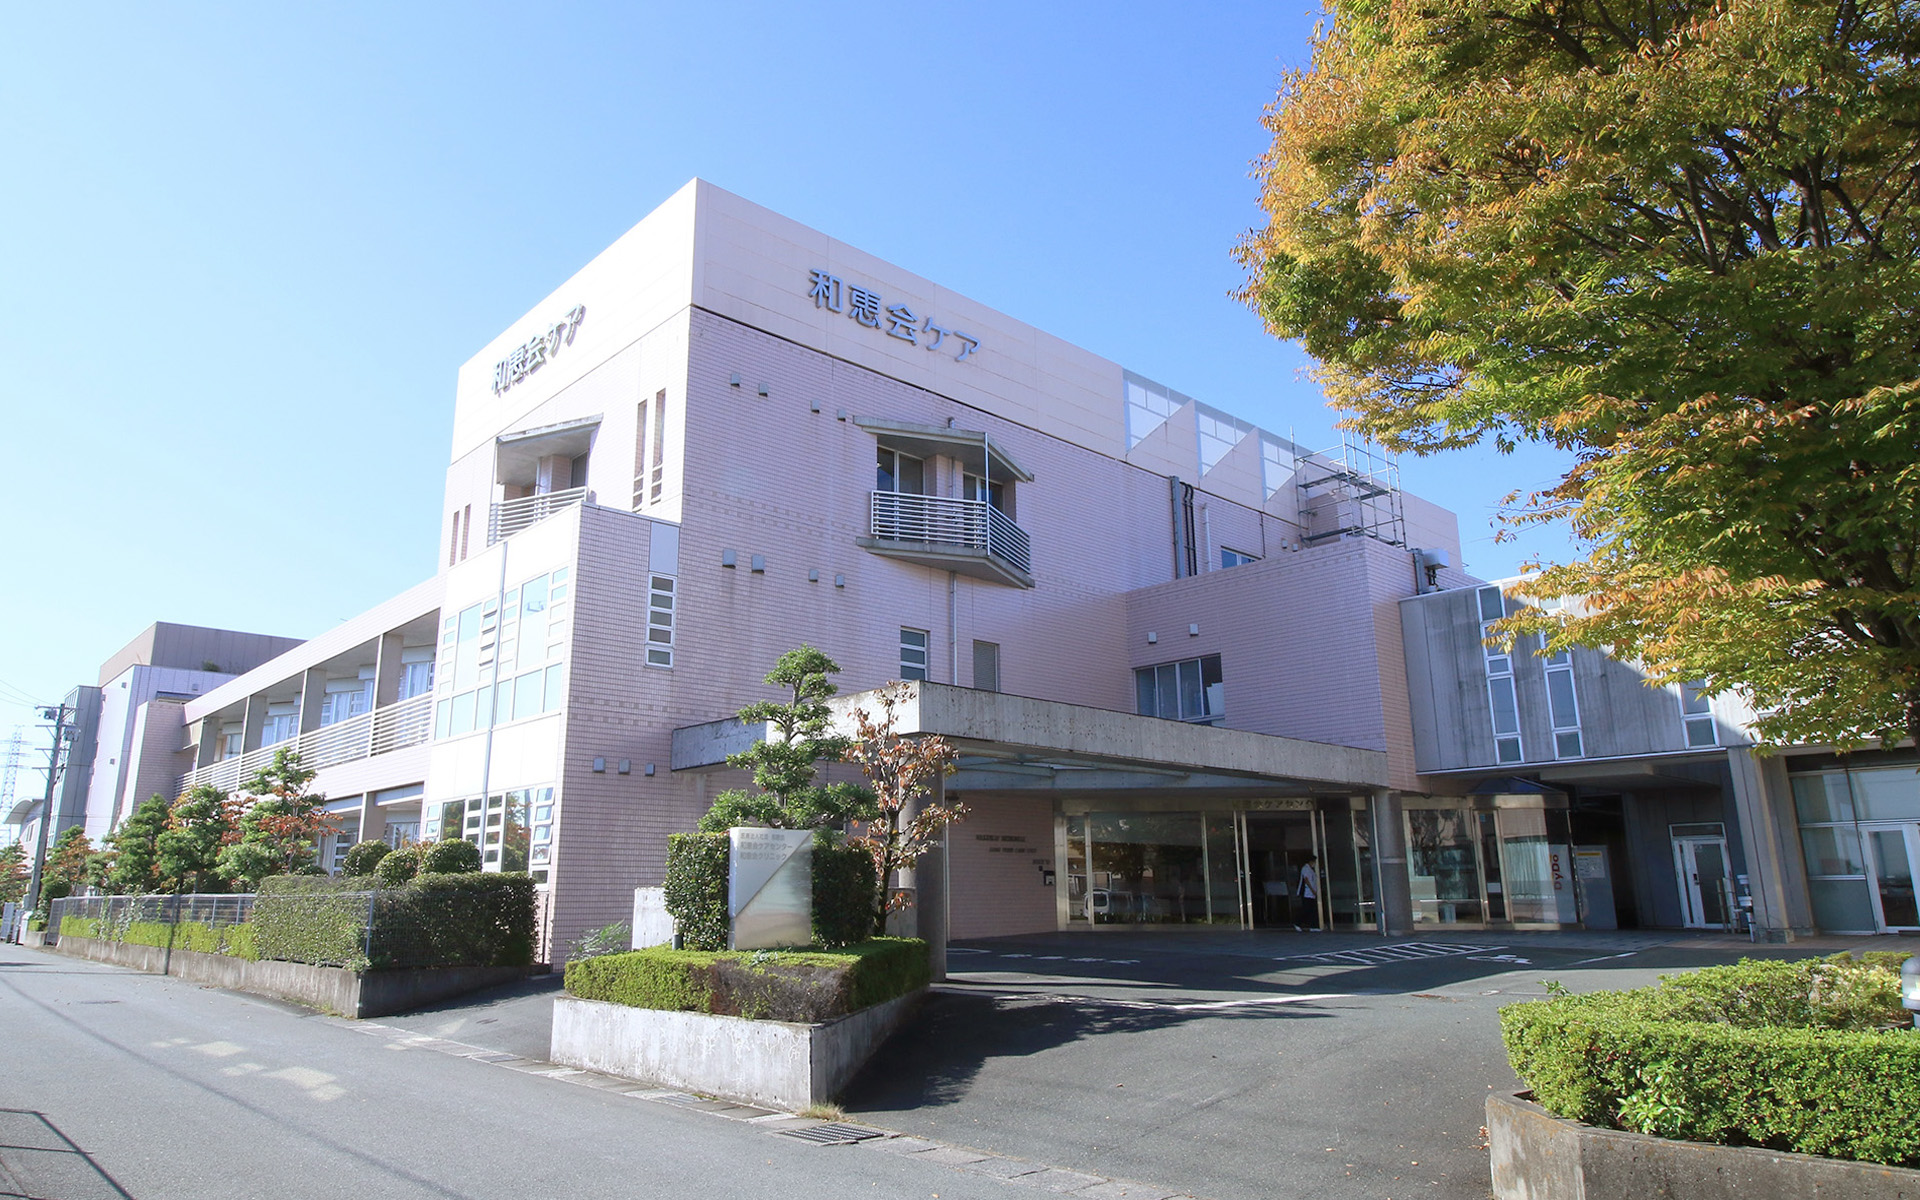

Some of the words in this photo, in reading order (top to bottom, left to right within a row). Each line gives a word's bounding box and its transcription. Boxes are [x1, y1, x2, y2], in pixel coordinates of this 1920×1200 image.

[808, 268, 982, 362] 和恵会ケア
[1552, 854, 1564, 890] DyDo
